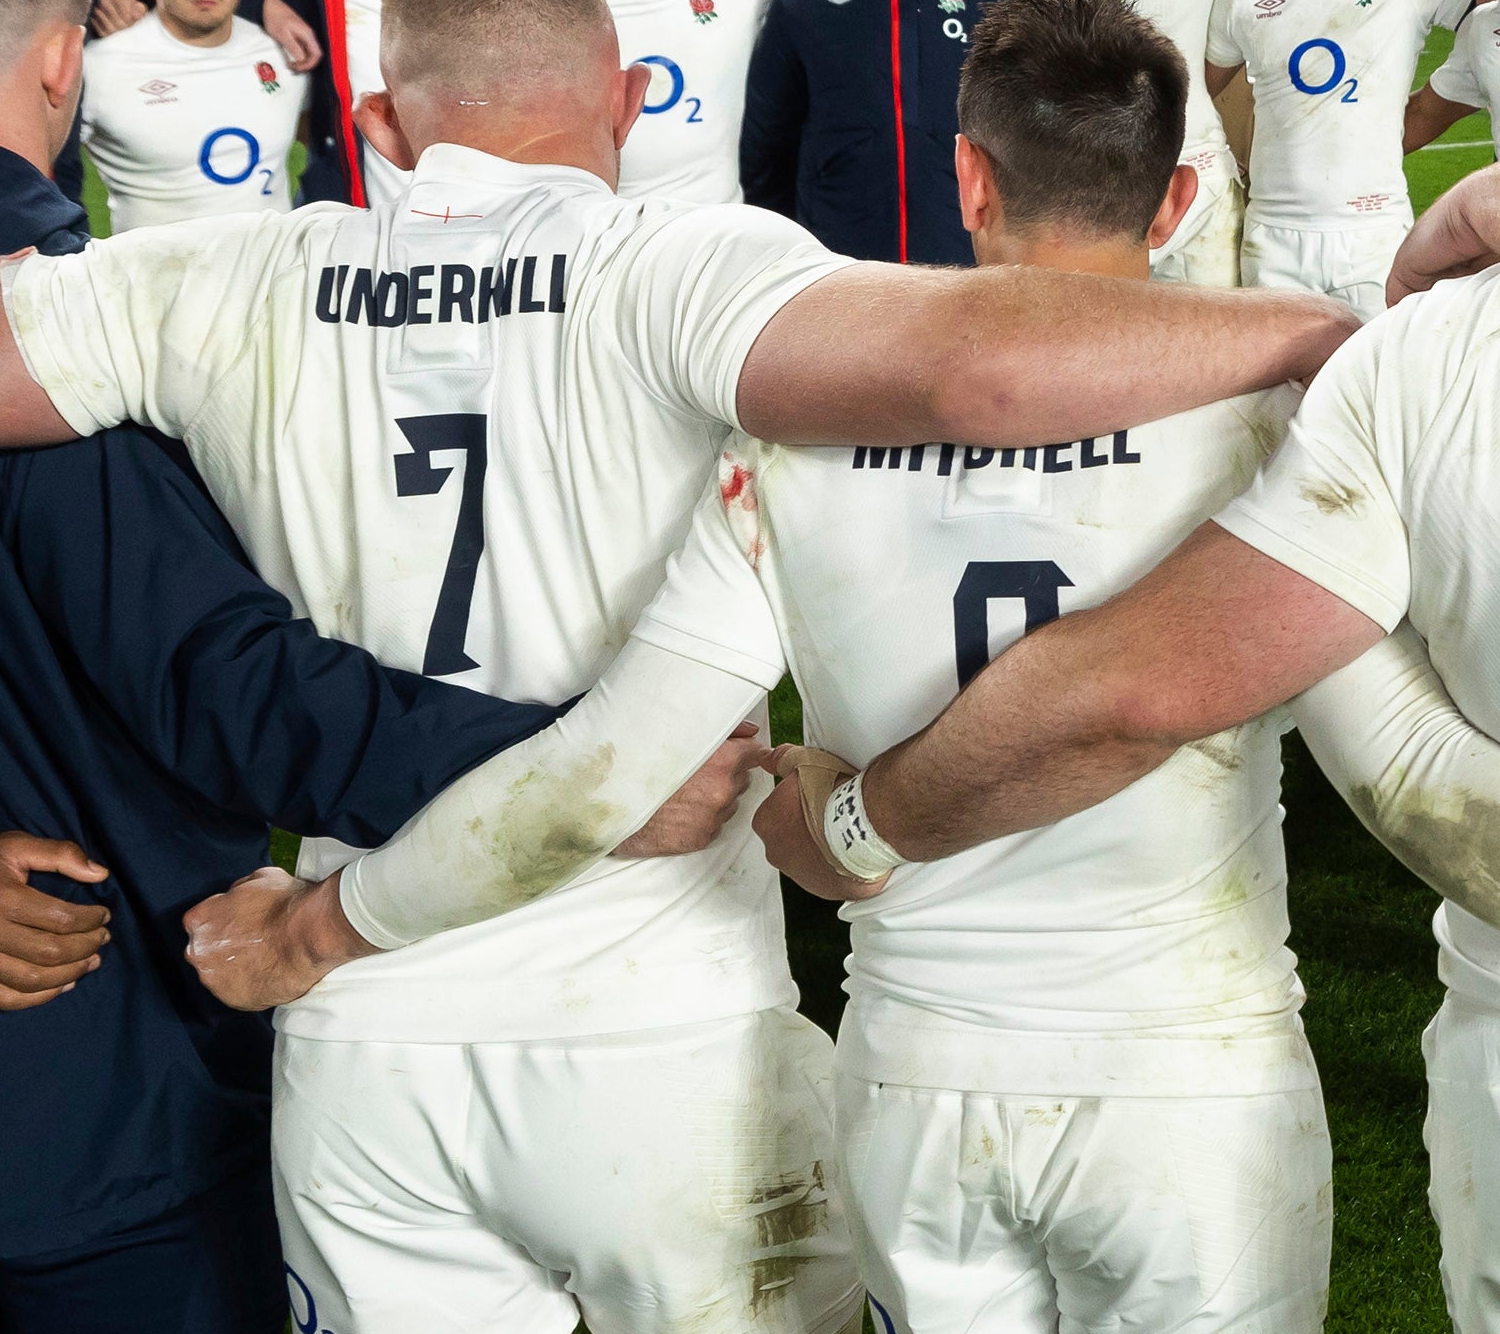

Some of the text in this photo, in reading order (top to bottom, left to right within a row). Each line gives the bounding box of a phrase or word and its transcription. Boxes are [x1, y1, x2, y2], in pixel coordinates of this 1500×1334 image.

[1256, 10, 1282, 19] umbro
[1288, 38, 1359, 103] O2
[199, 127, 272, 195] O2
[315, 253, 567, 328] UNDERHILL
[393, 413, 489, 677] 7
